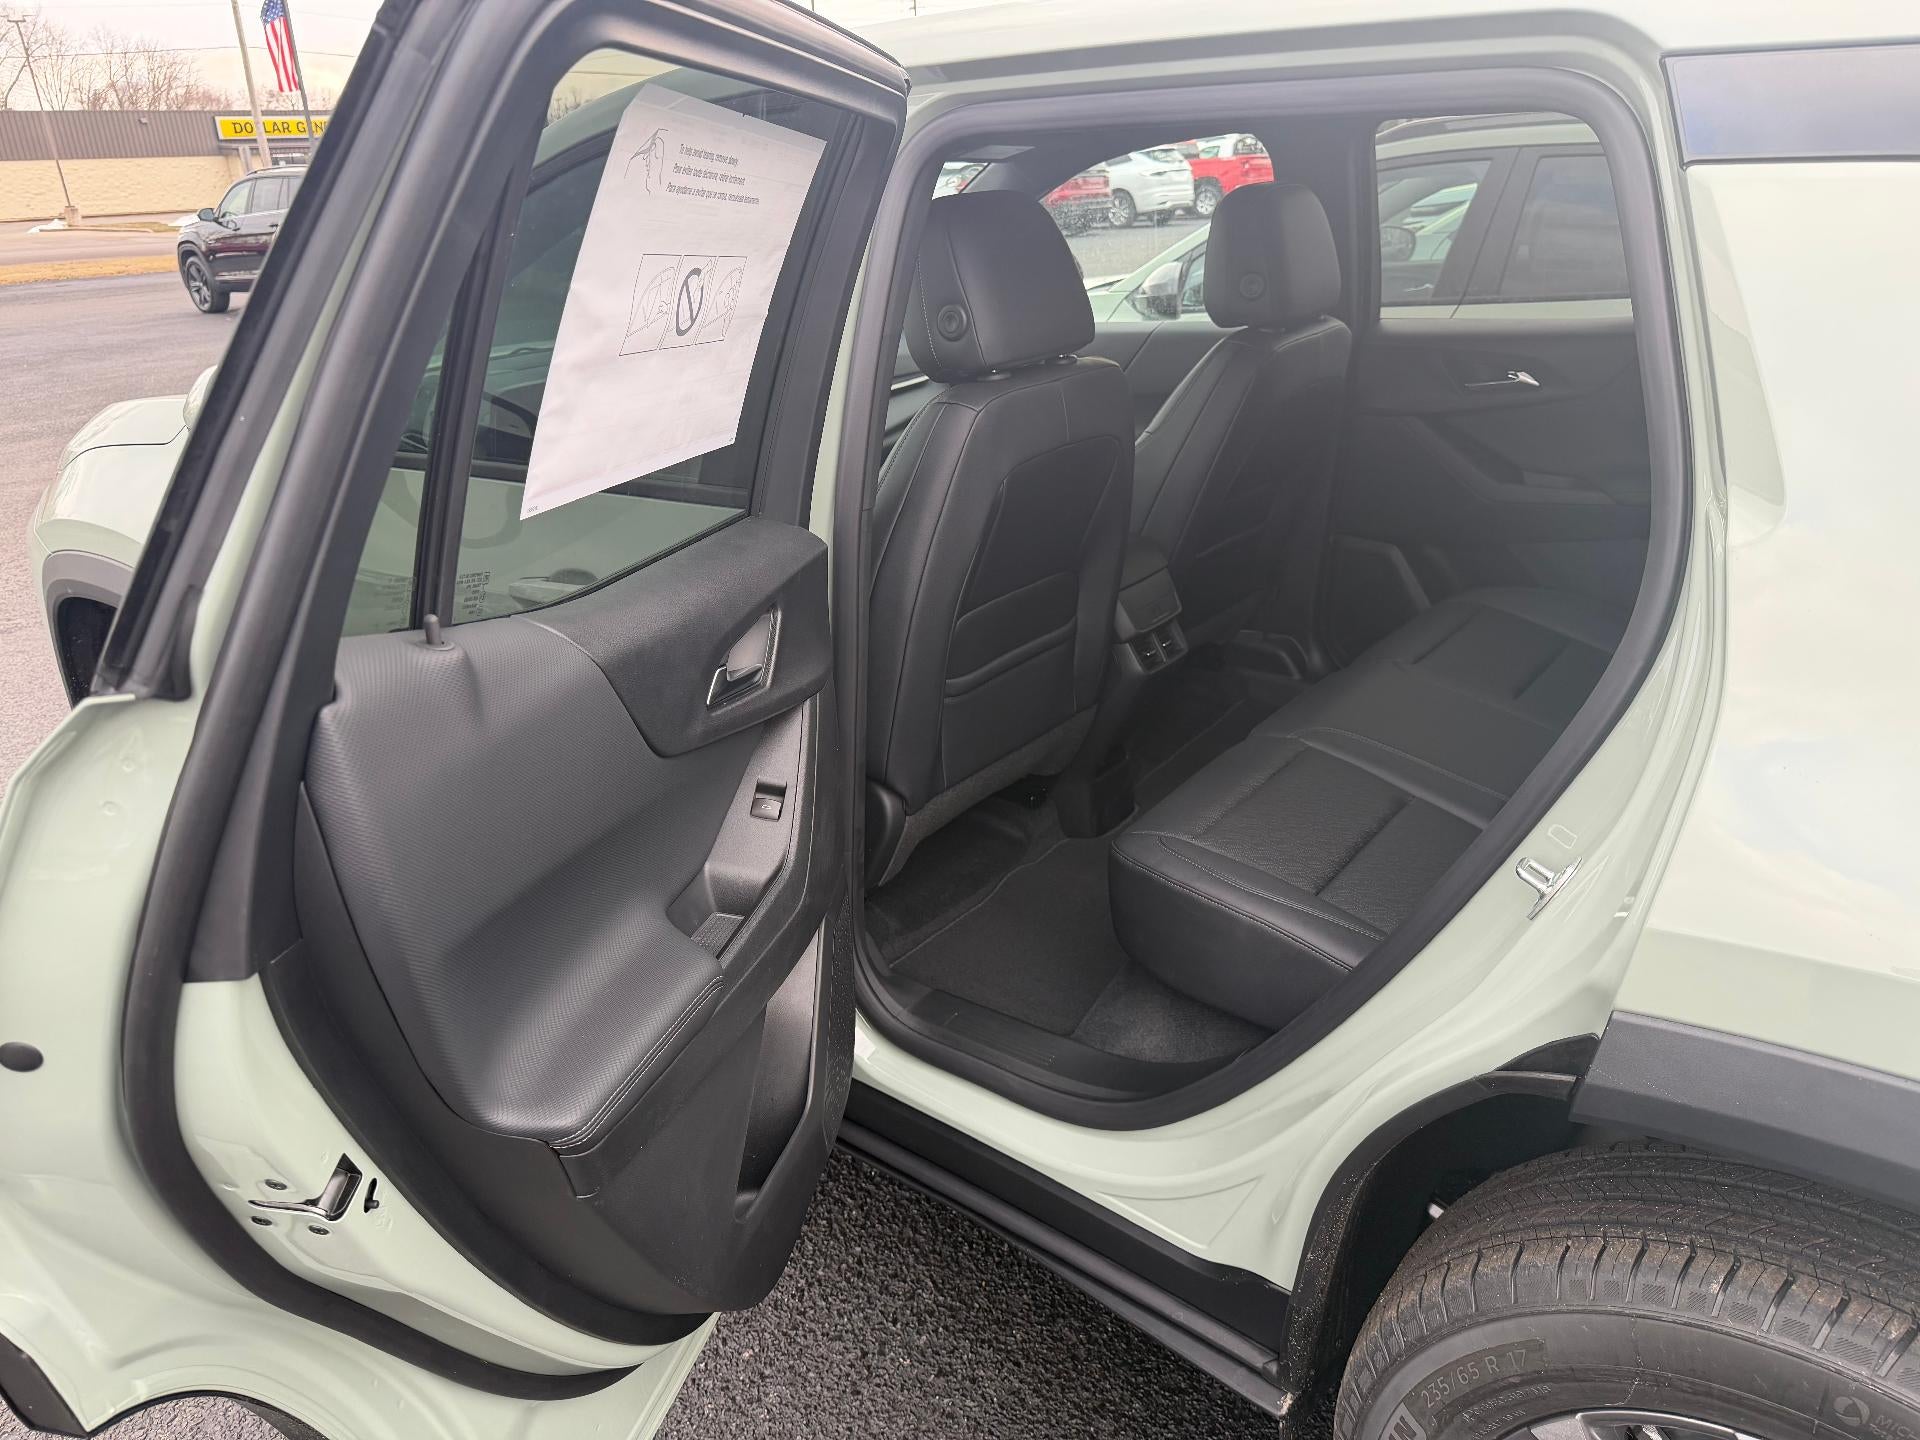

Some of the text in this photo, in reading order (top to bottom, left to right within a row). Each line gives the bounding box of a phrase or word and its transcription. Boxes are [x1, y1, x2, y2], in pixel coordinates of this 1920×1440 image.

[231, 121, 291, 134] DOLAR
[1421, 1361, 1480, 1409] 235/65
[1485, 1355, 1500, 1375] R
[1507, 1349, 1527, 1372] 17
